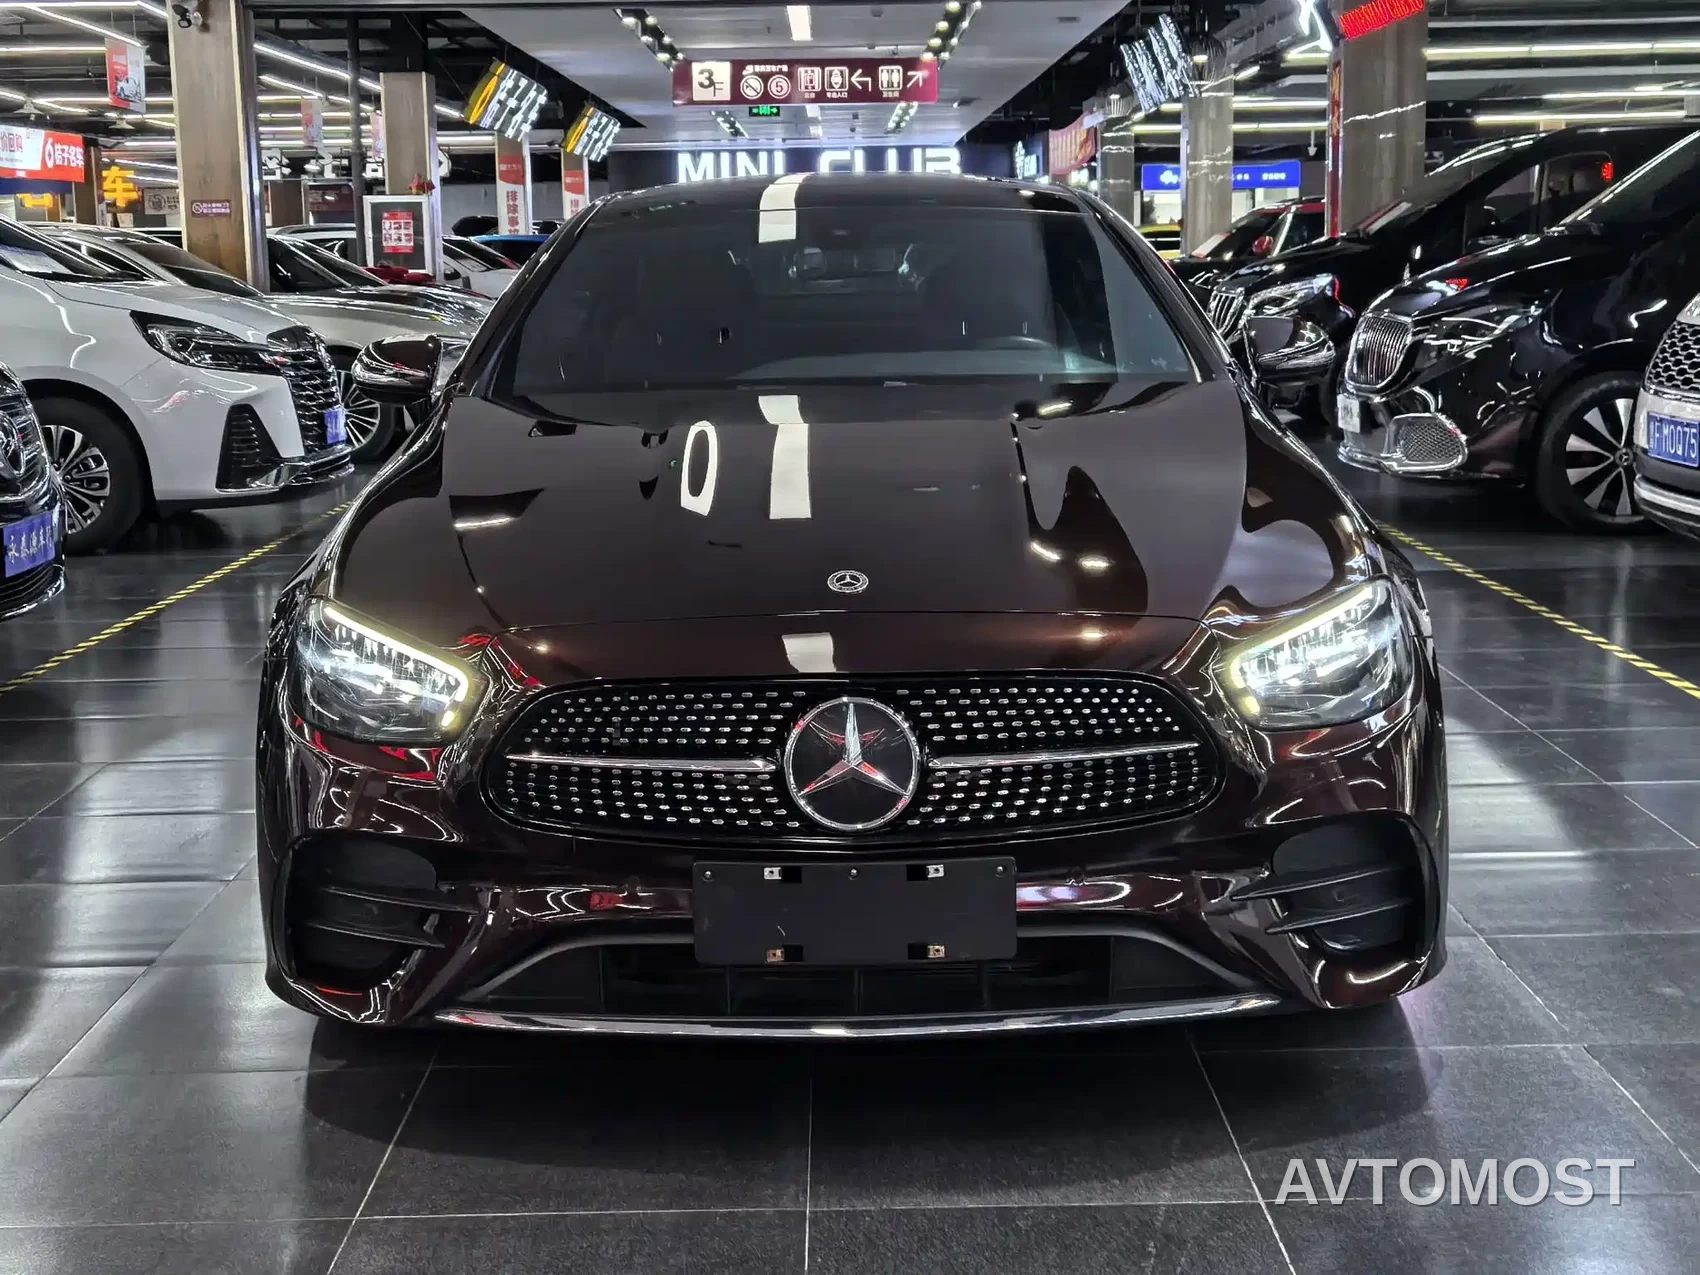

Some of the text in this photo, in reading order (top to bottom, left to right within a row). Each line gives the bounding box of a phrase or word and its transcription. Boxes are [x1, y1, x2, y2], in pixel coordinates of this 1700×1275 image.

[775, 80, 784, 93] 5
[677, 150, 785, 183] MINI
[102, 165, 139, 207] 车
